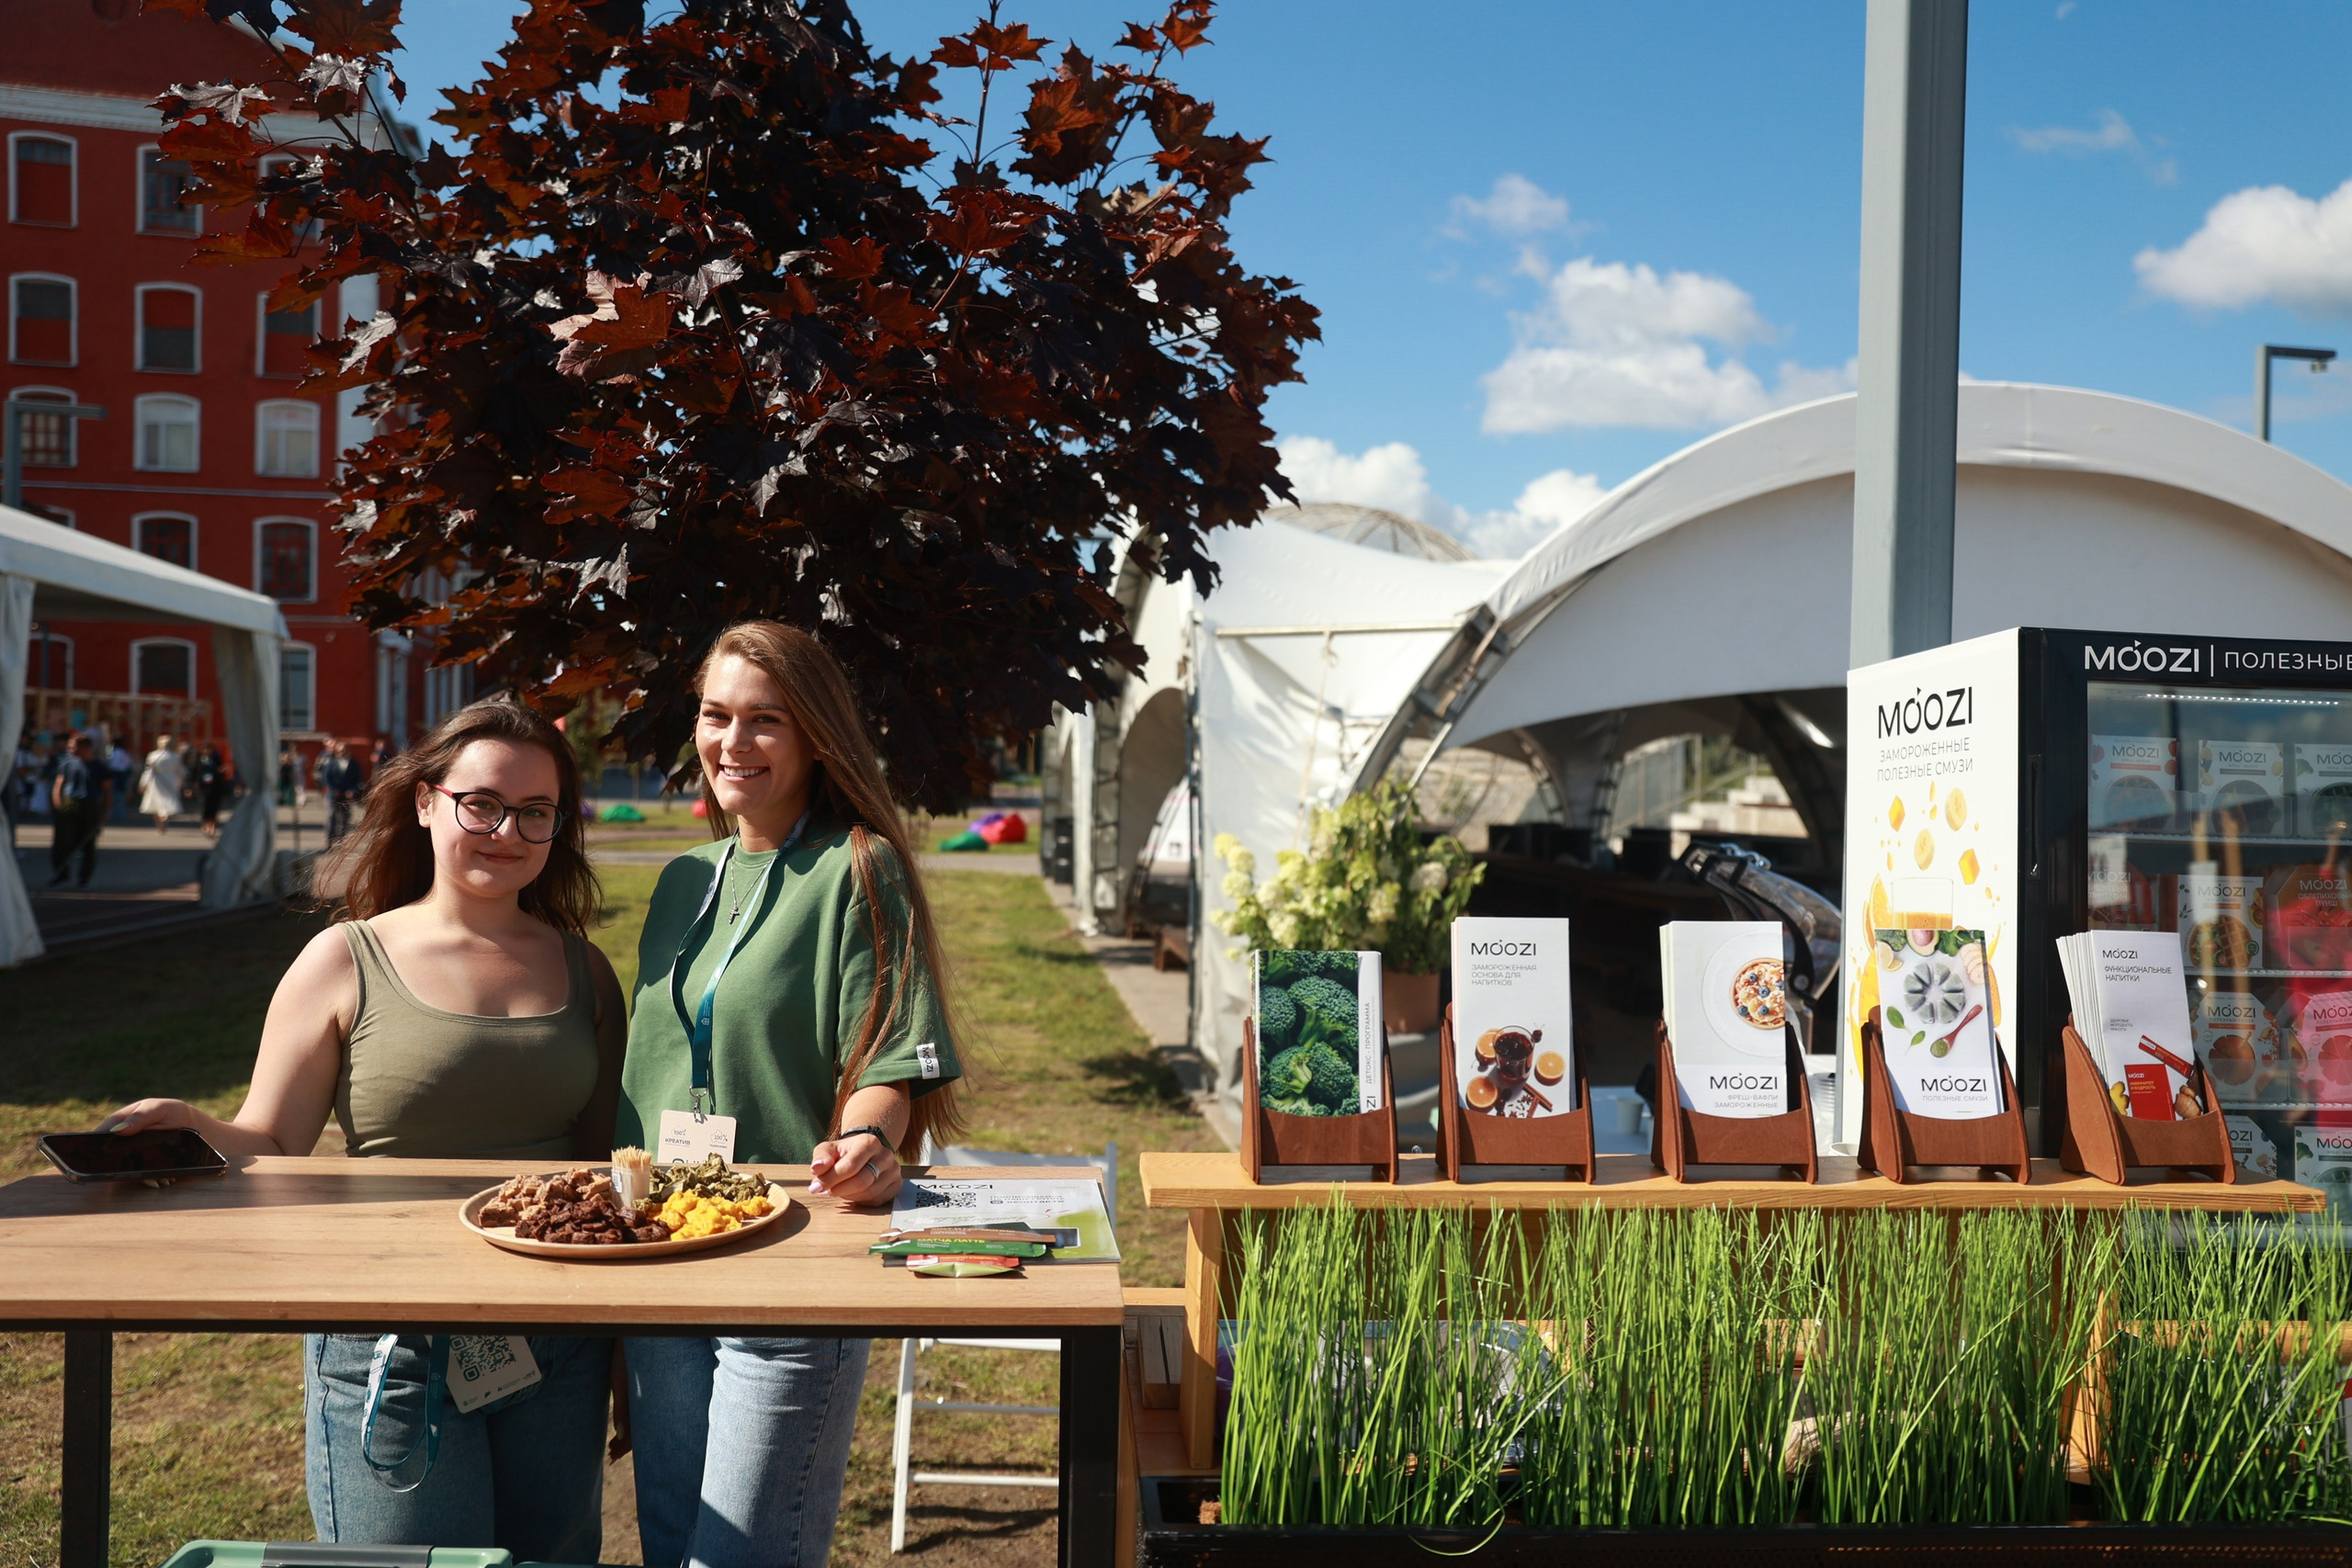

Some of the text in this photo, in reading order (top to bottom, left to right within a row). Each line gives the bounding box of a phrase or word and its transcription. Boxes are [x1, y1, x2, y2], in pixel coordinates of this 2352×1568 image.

[1880, 737, 1971, 763] ЗАМОРОЖЕННЫЕ
[1877, 758, 1973, 783] ПОЛЕЗНЫЕ СМУЗИ
[2315, 899, 2338, 908] ПУНШ
[2104, 965, 2172, 975] ФУНКЦИОНАЛЬНЫЕ
[1504, 971, 1521, 979] ДЛЯ
[2105, 974, 2141, 983] НАПИТКИ
[1922, 1094, 1962, 1102] ПОЛЕЗНЫЕ
[2229, 1130, 2253, 1142] OZI
[664, 1137, 691, 1146] КРЕАТИВ
